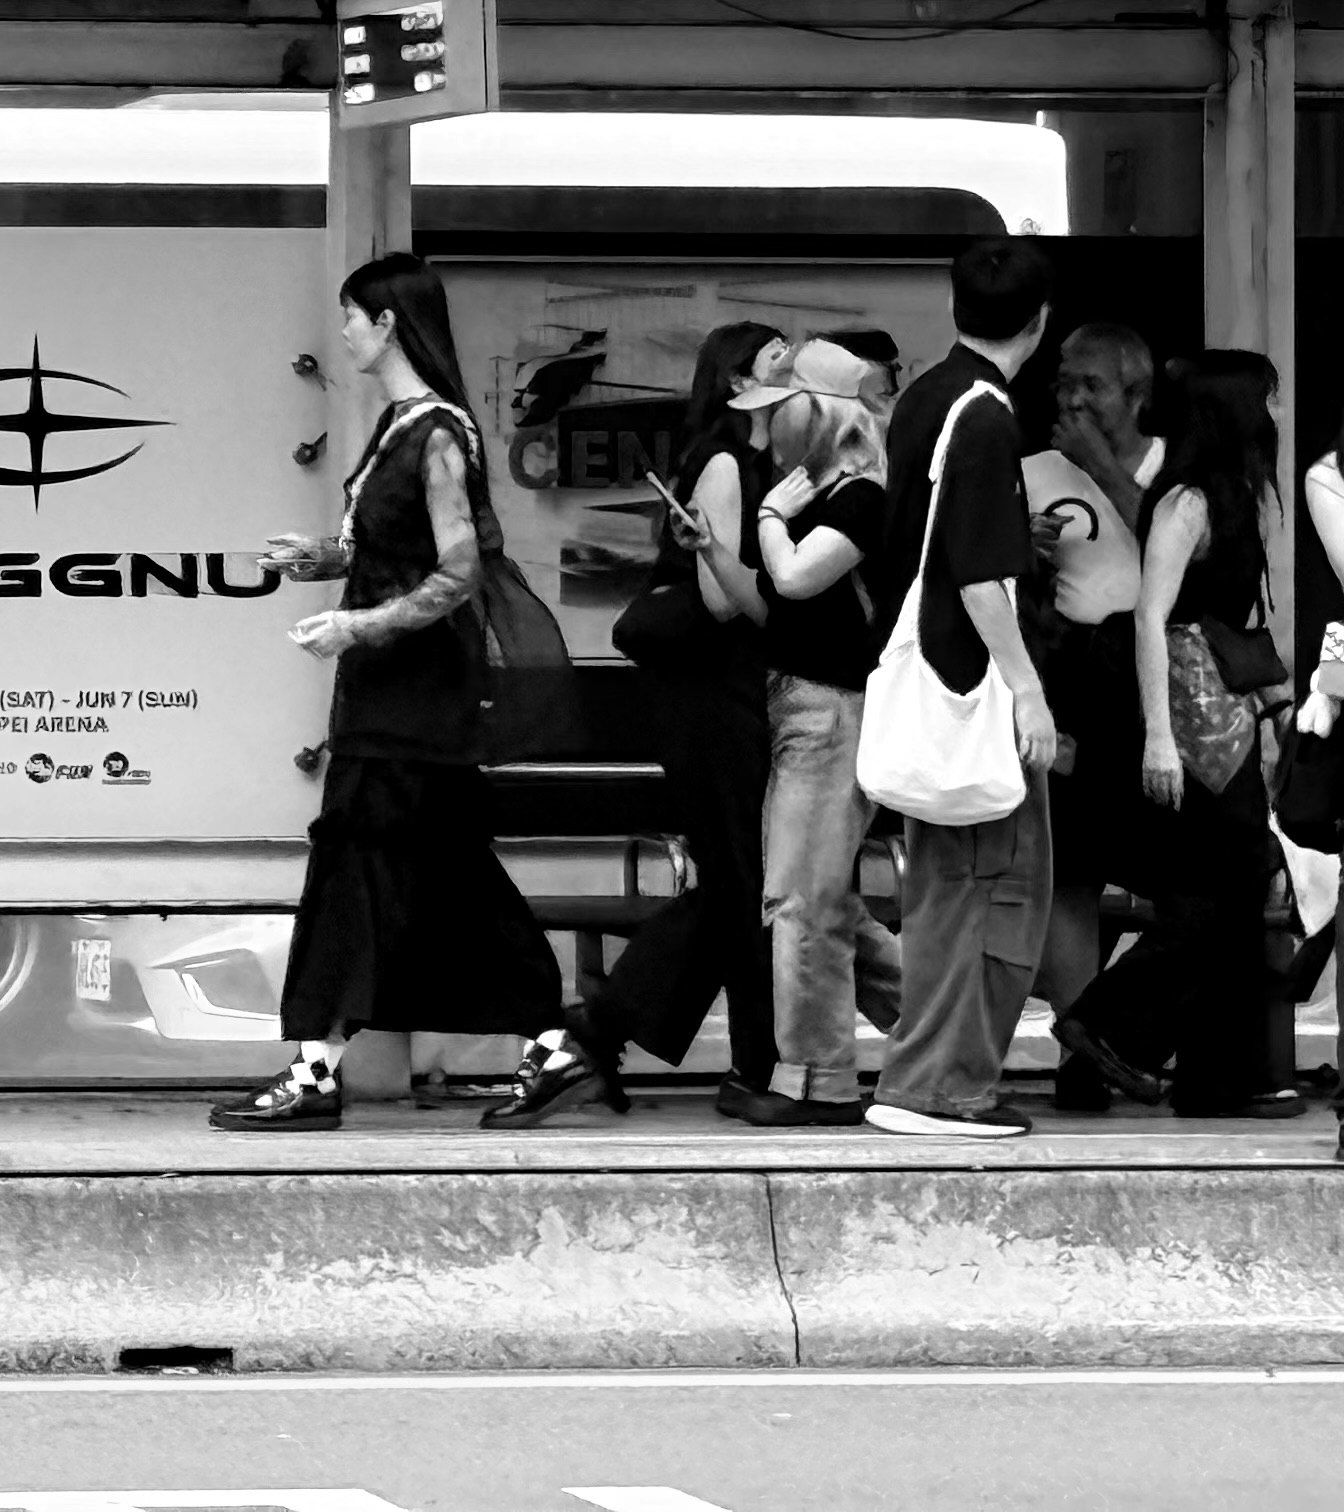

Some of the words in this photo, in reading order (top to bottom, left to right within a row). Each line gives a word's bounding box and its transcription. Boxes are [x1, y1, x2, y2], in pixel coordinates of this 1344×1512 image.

[509, 431, 672, 489] CEN
[0, 689, 55, 712] (SAT)
[76, 690, 116, 709] JUN
[121, 690, 133, 709] 7
[138, 689, 198, 712] (SUN)
[34, 716, 110, 733] ARENA
